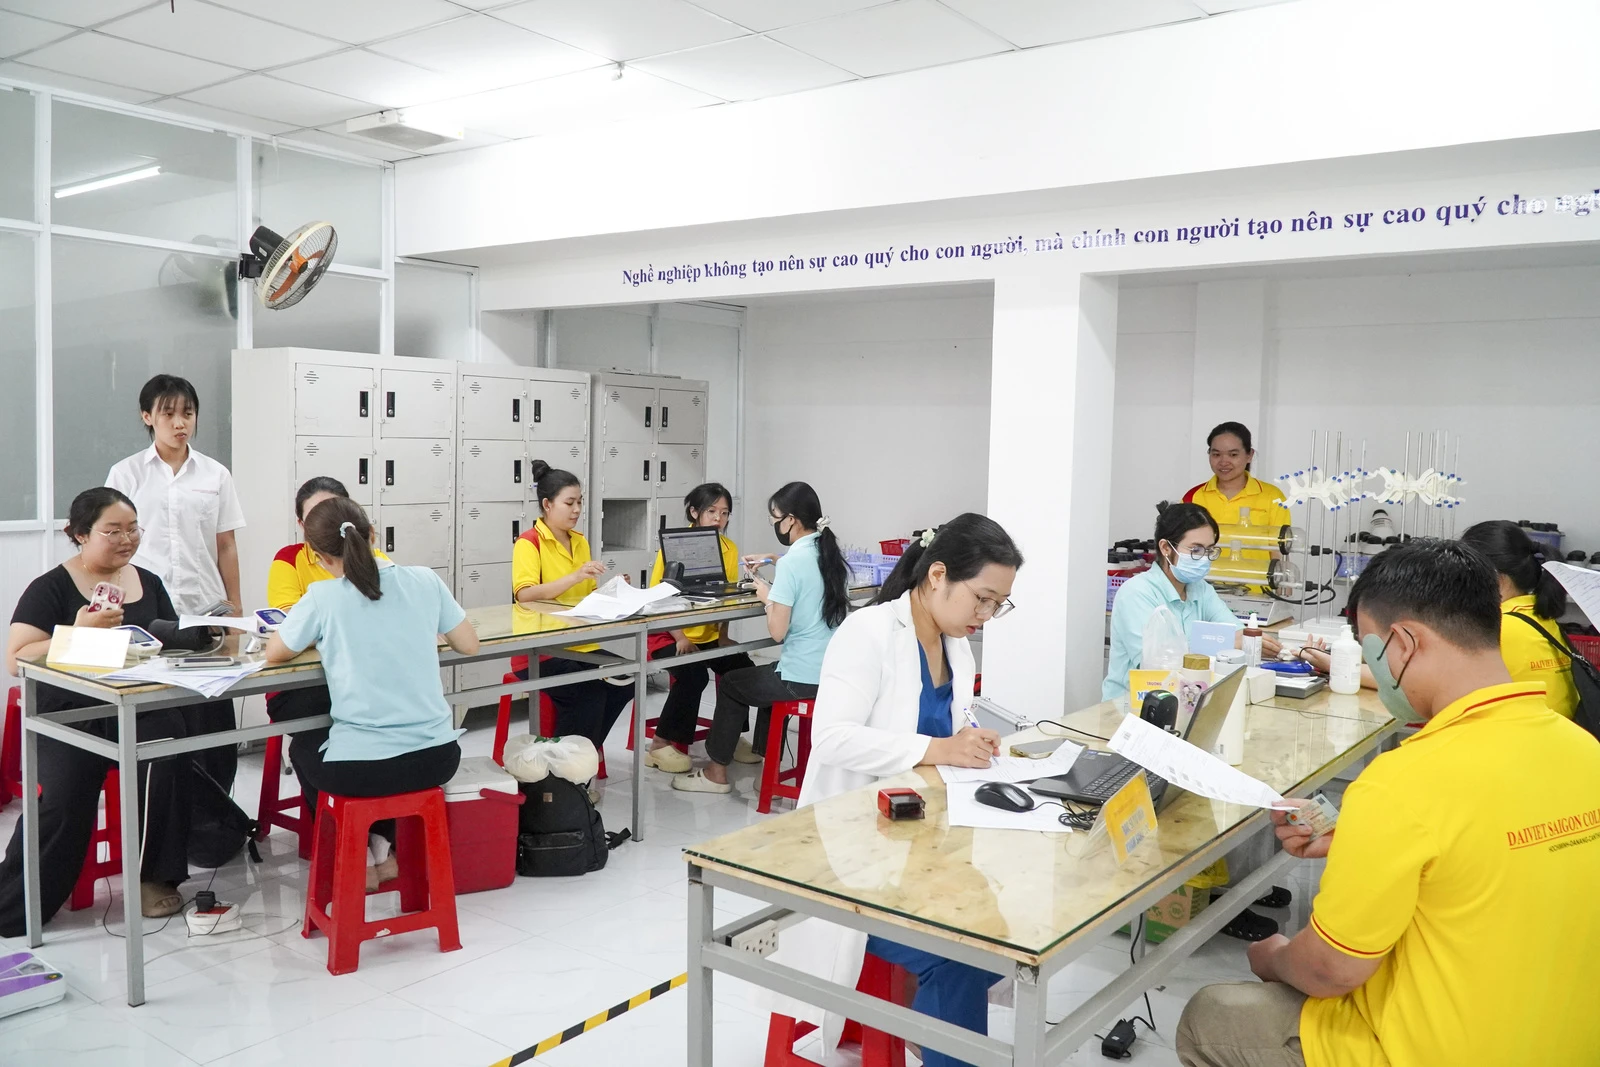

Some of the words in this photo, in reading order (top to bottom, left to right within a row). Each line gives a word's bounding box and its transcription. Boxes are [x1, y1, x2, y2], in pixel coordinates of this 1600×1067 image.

[623, 264, 654, 287] Nghề
[658, 264, 701, 284] nghiệp
[704, 261, 747, 279] không
[753, 260, 774, 276] tạo
[779, 255, 804, 271] nên
[809, 256, 827, 272] sự
[832, 254, 858, 267] cao
[865, 247, 894, 268] quý
[900, 245, 929, 261] cho
[936, 245, 964, 259] con
[971, 235, 1028, 260] người,
[1035, 232, 1063, 251] mà
[1071, 228, 1126, 249] chính
[1134, 228, 1169, 243] con
[1176, 217, 1240, 244] người
[1247, 218, 1283, 239] tạo
[1291, 210, 1333, 232] nên
[1344, 212, 1374, 232] sự
[1383, 207, 1426, 224] cao
[1436, 196, 1487, 226] quý
[1497, 194, 1547, 215] cho
[1507, 823, 1547, 846] DAIVIET
[1547, 814, 1582, 837] SAIGON
